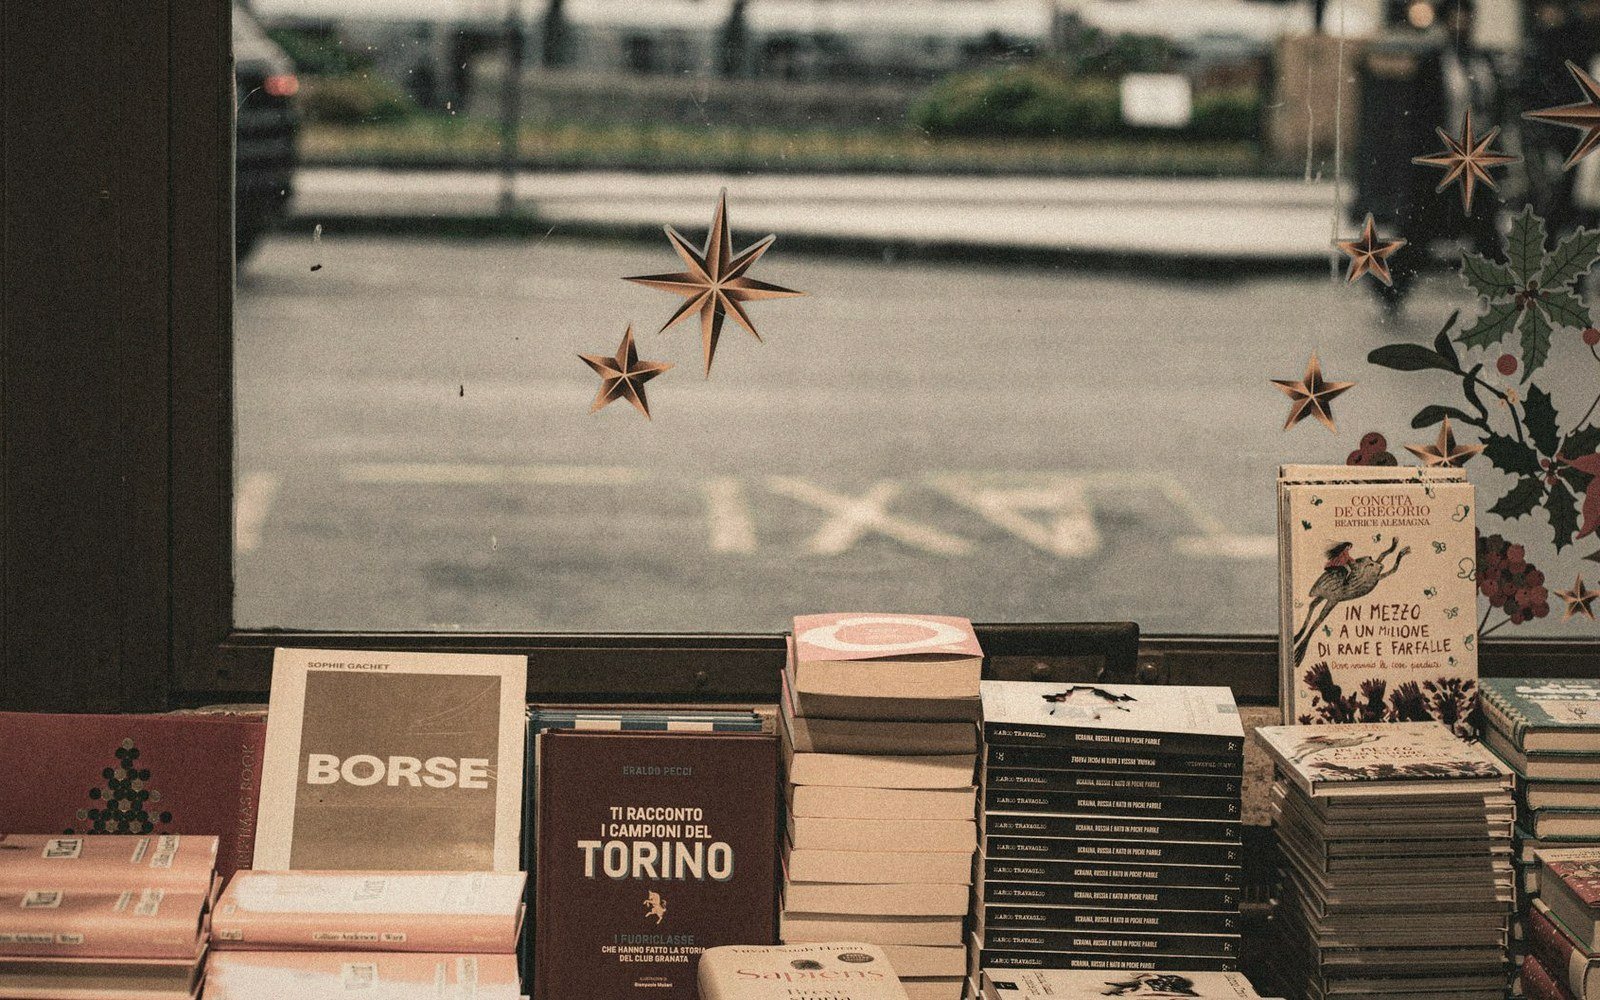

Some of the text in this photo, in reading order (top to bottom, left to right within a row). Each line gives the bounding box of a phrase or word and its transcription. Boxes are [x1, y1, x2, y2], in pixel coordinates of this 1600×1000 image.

[1351, 495, 1413, 507] CONCITA
[1334, 505, 1430, 518] DE GREGORIO
[1335, 518, 1430, 528] BEATRICE ALEMAGNA
[1345, 603, 1421, 621] IN MEZZO
[1339, 624, 1430, 638] A UN MILIONE
[1317, 638, 1451, 658] DI RANE E FARFALLE
[307, 661, 345, 669] SOPHIE
[240, 744, 255, 791] BOOK
[307, 753, 489, 789] BORSE
[623, 766, 692, 776] ERALDO PECCI
[610, 806, 703, 821] TI RACCONTO
[601, 823, 712, 839] I CAMPIONI DEL
[577, 840, 734, 881] TORINO
[620, 934, 695, 945] FUORICLASSE
[618, 946, 644, 954] HANNO
[645, 946, 668, 954] FATTO
[669, 946, 680, 954] LA
[680, 946, 707, 954] STORIA
[620, 954, 634, 962] DEL
[655, 955, 689, 963] GRANATA
[736, 968, 884, 982] Sapiens
